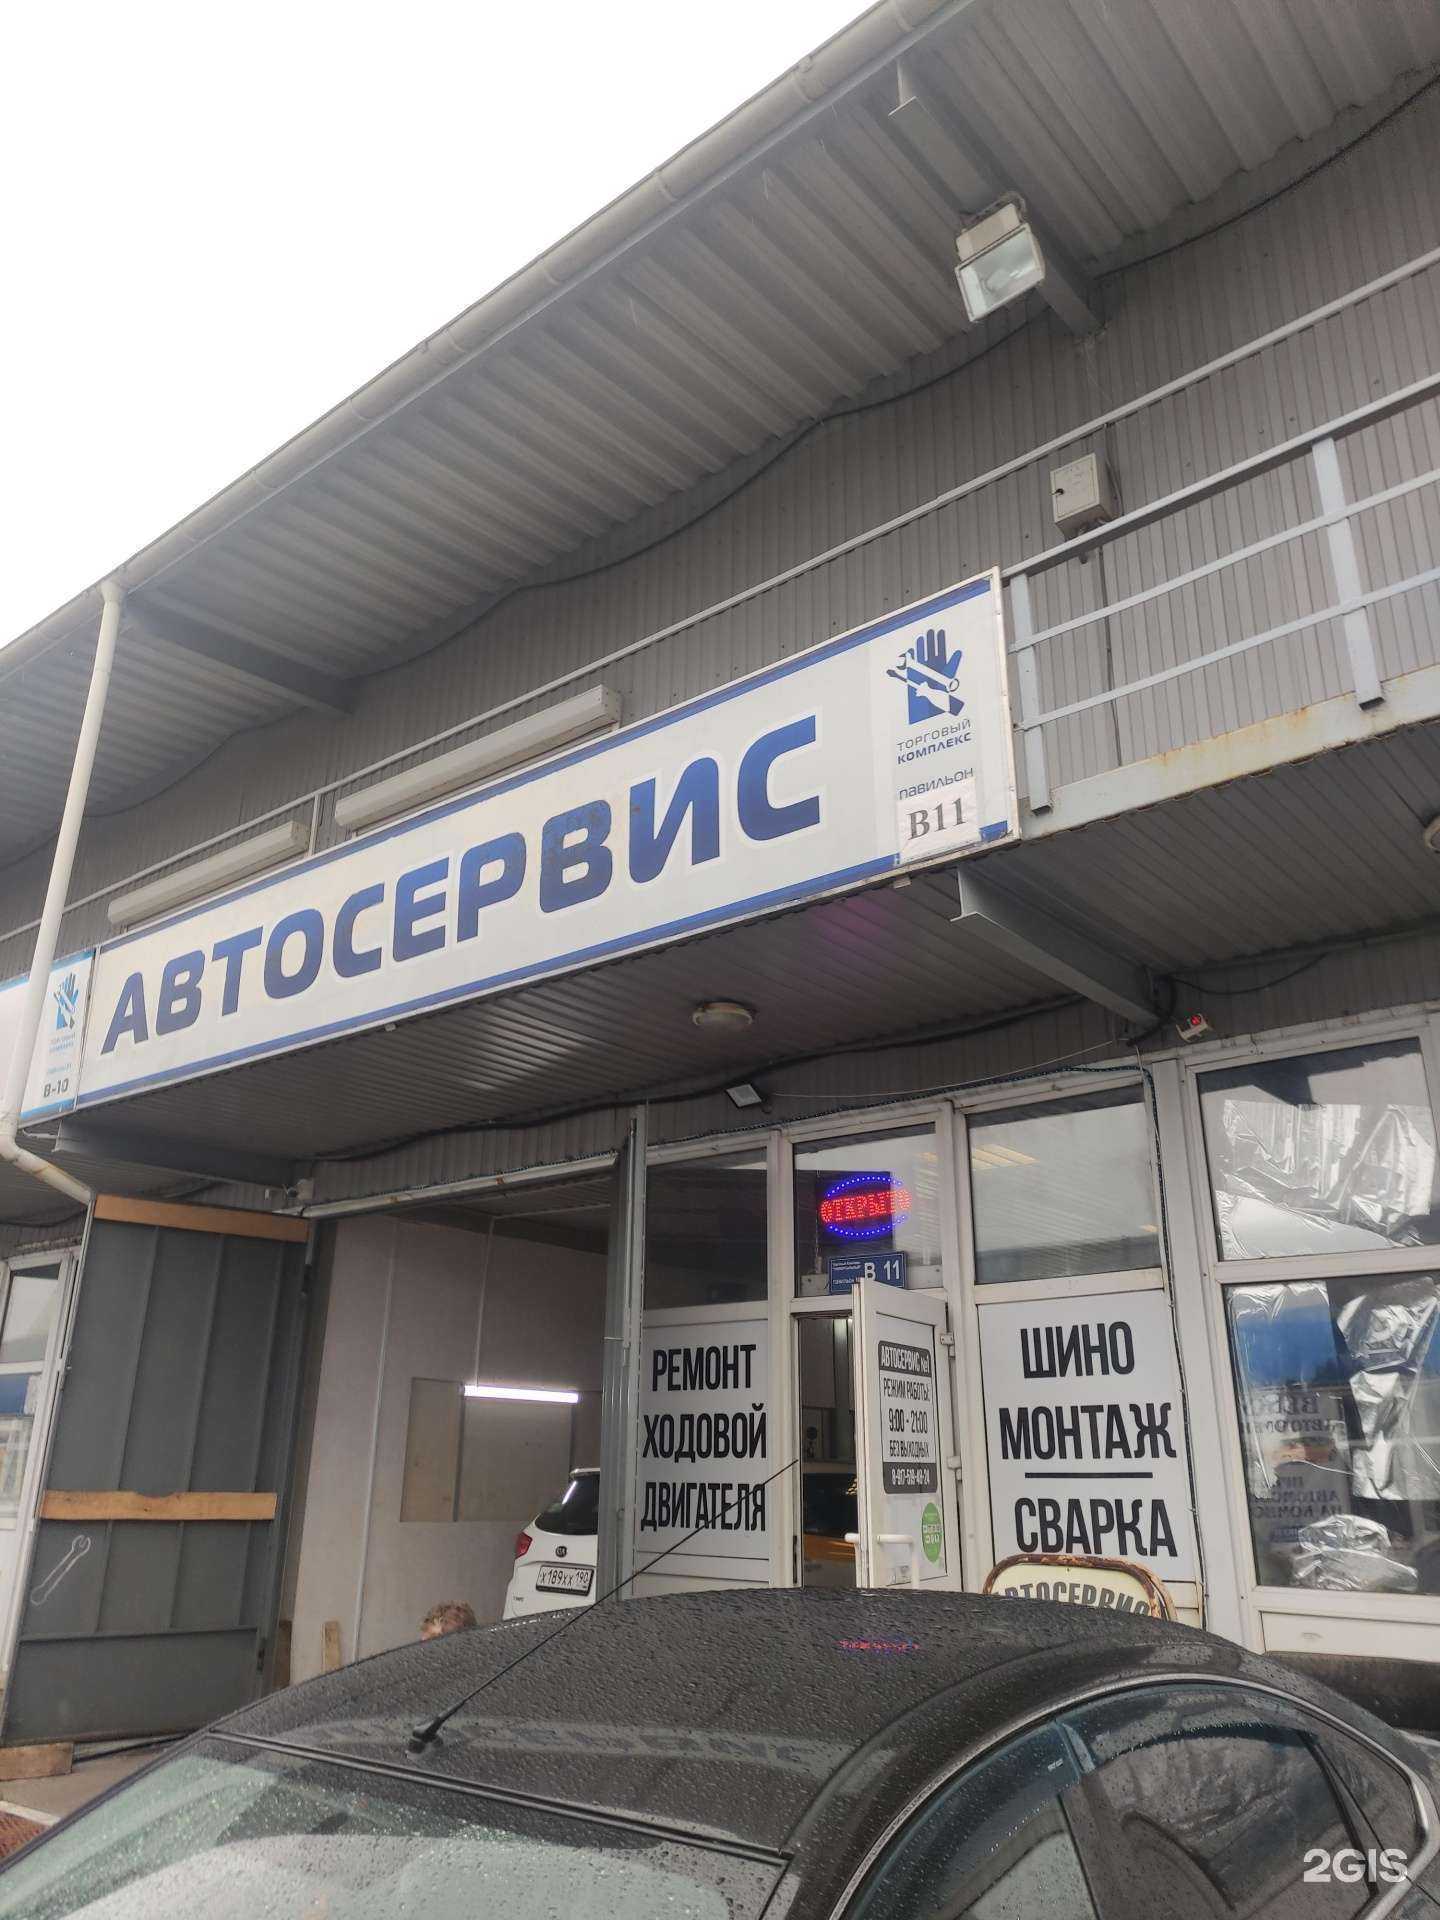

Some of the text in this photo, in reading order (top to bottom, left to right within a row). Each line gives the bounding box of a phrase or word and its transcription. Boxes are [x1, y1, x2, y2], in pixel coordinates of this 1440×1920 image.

[897, 718, 971, 751] ТОРГОВЫЙ
[897, 732, 972, 764] КОМПЛЕКС
[101, 714, 821, 1055] АВТОСЕРВИС
[820, 1189, 912, 1222] ОТКРЫТО
[883, 1260, 900, 1280] 11
[881, 1345, 920, 1372] АВТОСЕРВИС
[1020, 1321, 1135, 1379] ШИНО
[652, 1343, 756, 1392] РЕМОНТ
[883, 1377, 906, 1399] РЕЖИМ
[642, 1402, 767, 1463] ХОДОВОЙ
[889, 1408, 904, 1432] 9:00
[999, 1402, 1177, 1460] МОНТАЖ
[890, 1440, 900, 1457] БЕЗ
[640, 1480, 766, 1532] ДВИГАТЕЛЯ
[1014, 1498, 1178, 1557] СВАРКА
[991, 1581, 1150, 1616] ТОСЕРВИ
